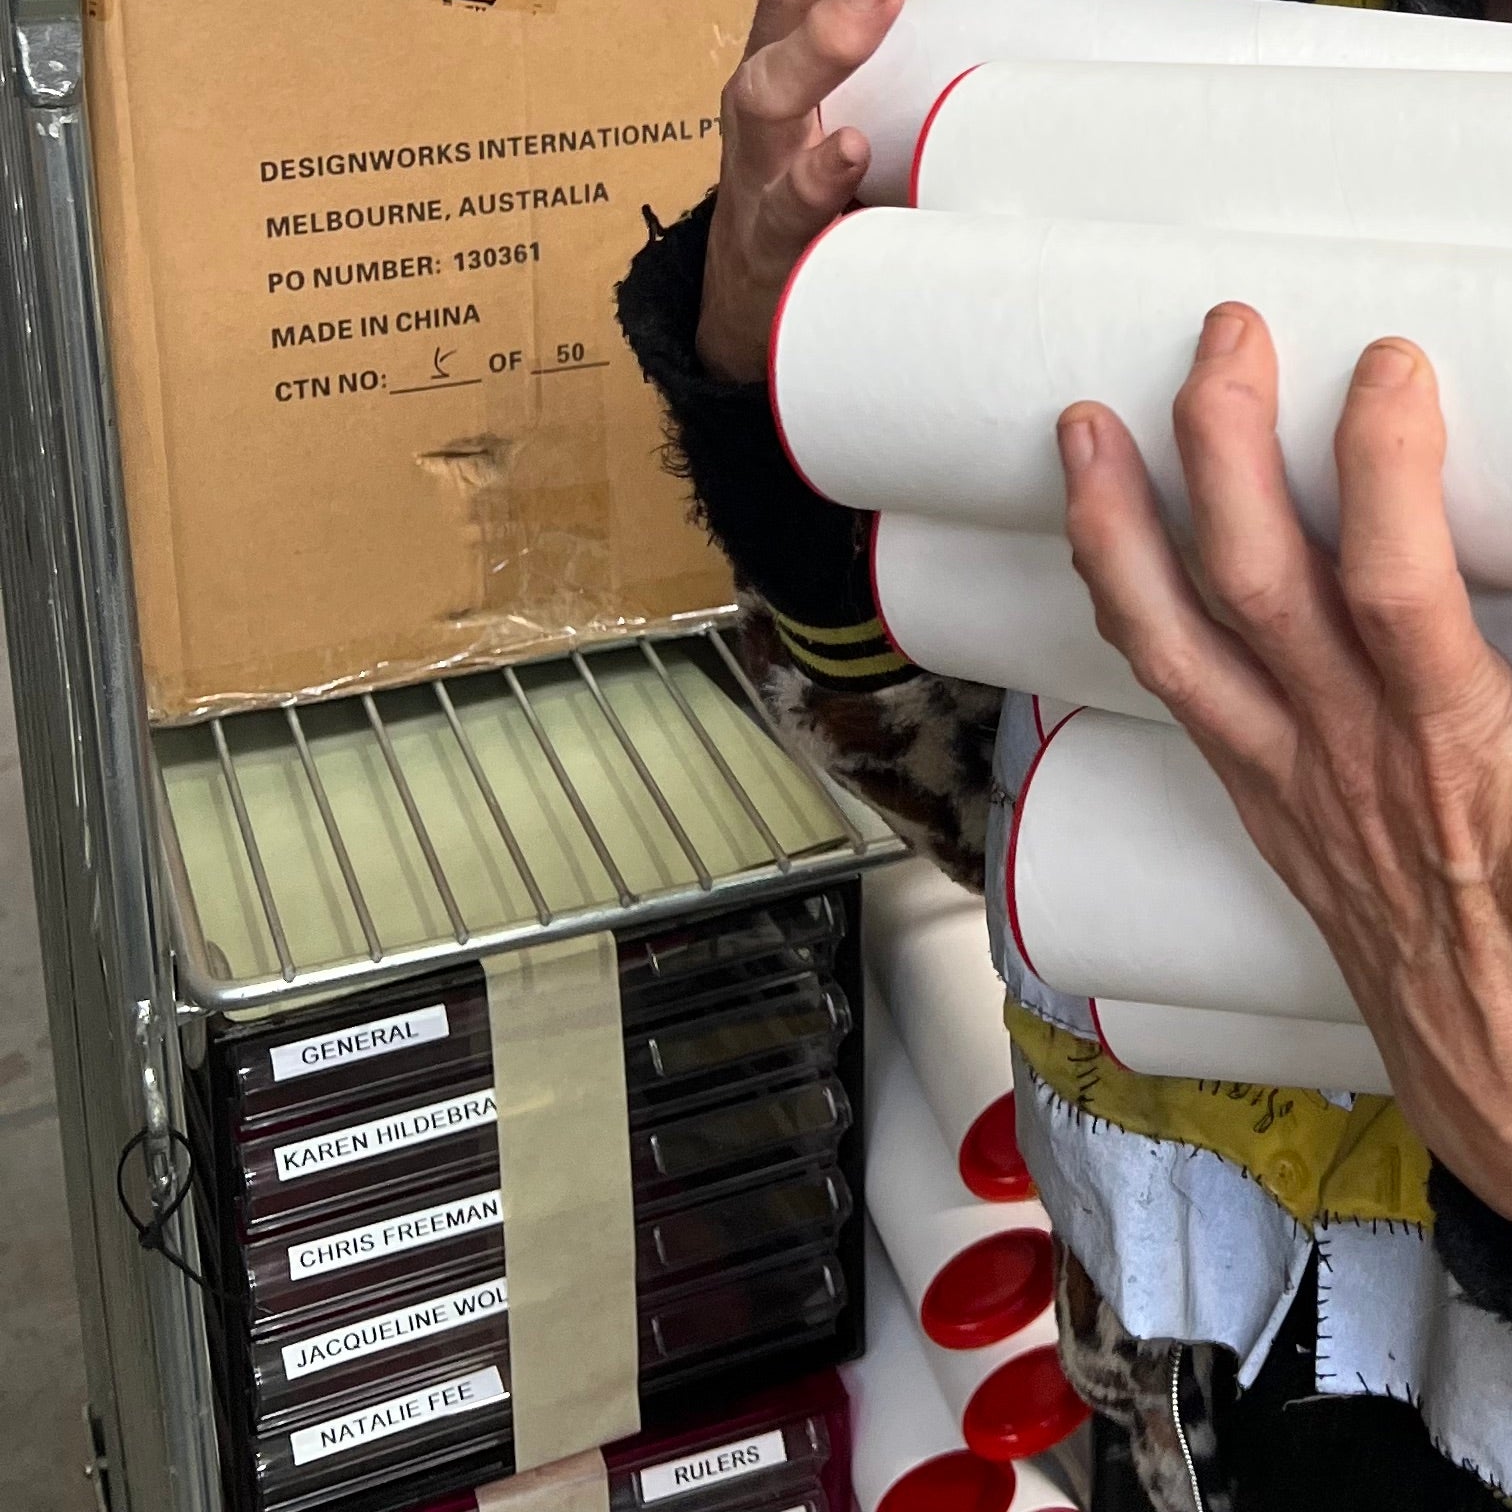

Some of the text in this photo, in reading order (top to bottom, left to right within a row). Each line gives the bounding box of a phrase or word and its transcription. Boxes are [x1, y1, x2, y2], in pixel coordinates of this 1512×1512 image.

[260, 142, 471, 183] DESIGNWORKS
[478, 120, 693, 160] INTERNATIONAL
[266, 182, 609, 238] MELBOURNE, AUSTRALIA
[268, 242, 541, 293] PO NUMBER: 130361
[271, 304, 481, 348] MADE IN CHINA
[274, 377, 330, 402] CTN
[338, 370, 388, 394] NO:
[489, 351, 523, 374] OF
[556, 343, 584, 364] 50
[301, 1021, 419, 1065] GENERAL
[283, 1096, 497, 1171] KAREN HILDEBRA
[299, 1199, 499, 1268] CHRIS FREEMAN
[297, 1304, 449, 1368] JACQUELINE
[320, 1381, 475, 1448] NATALIE FEE
[674, 1445, 760, 1485] RULERS
